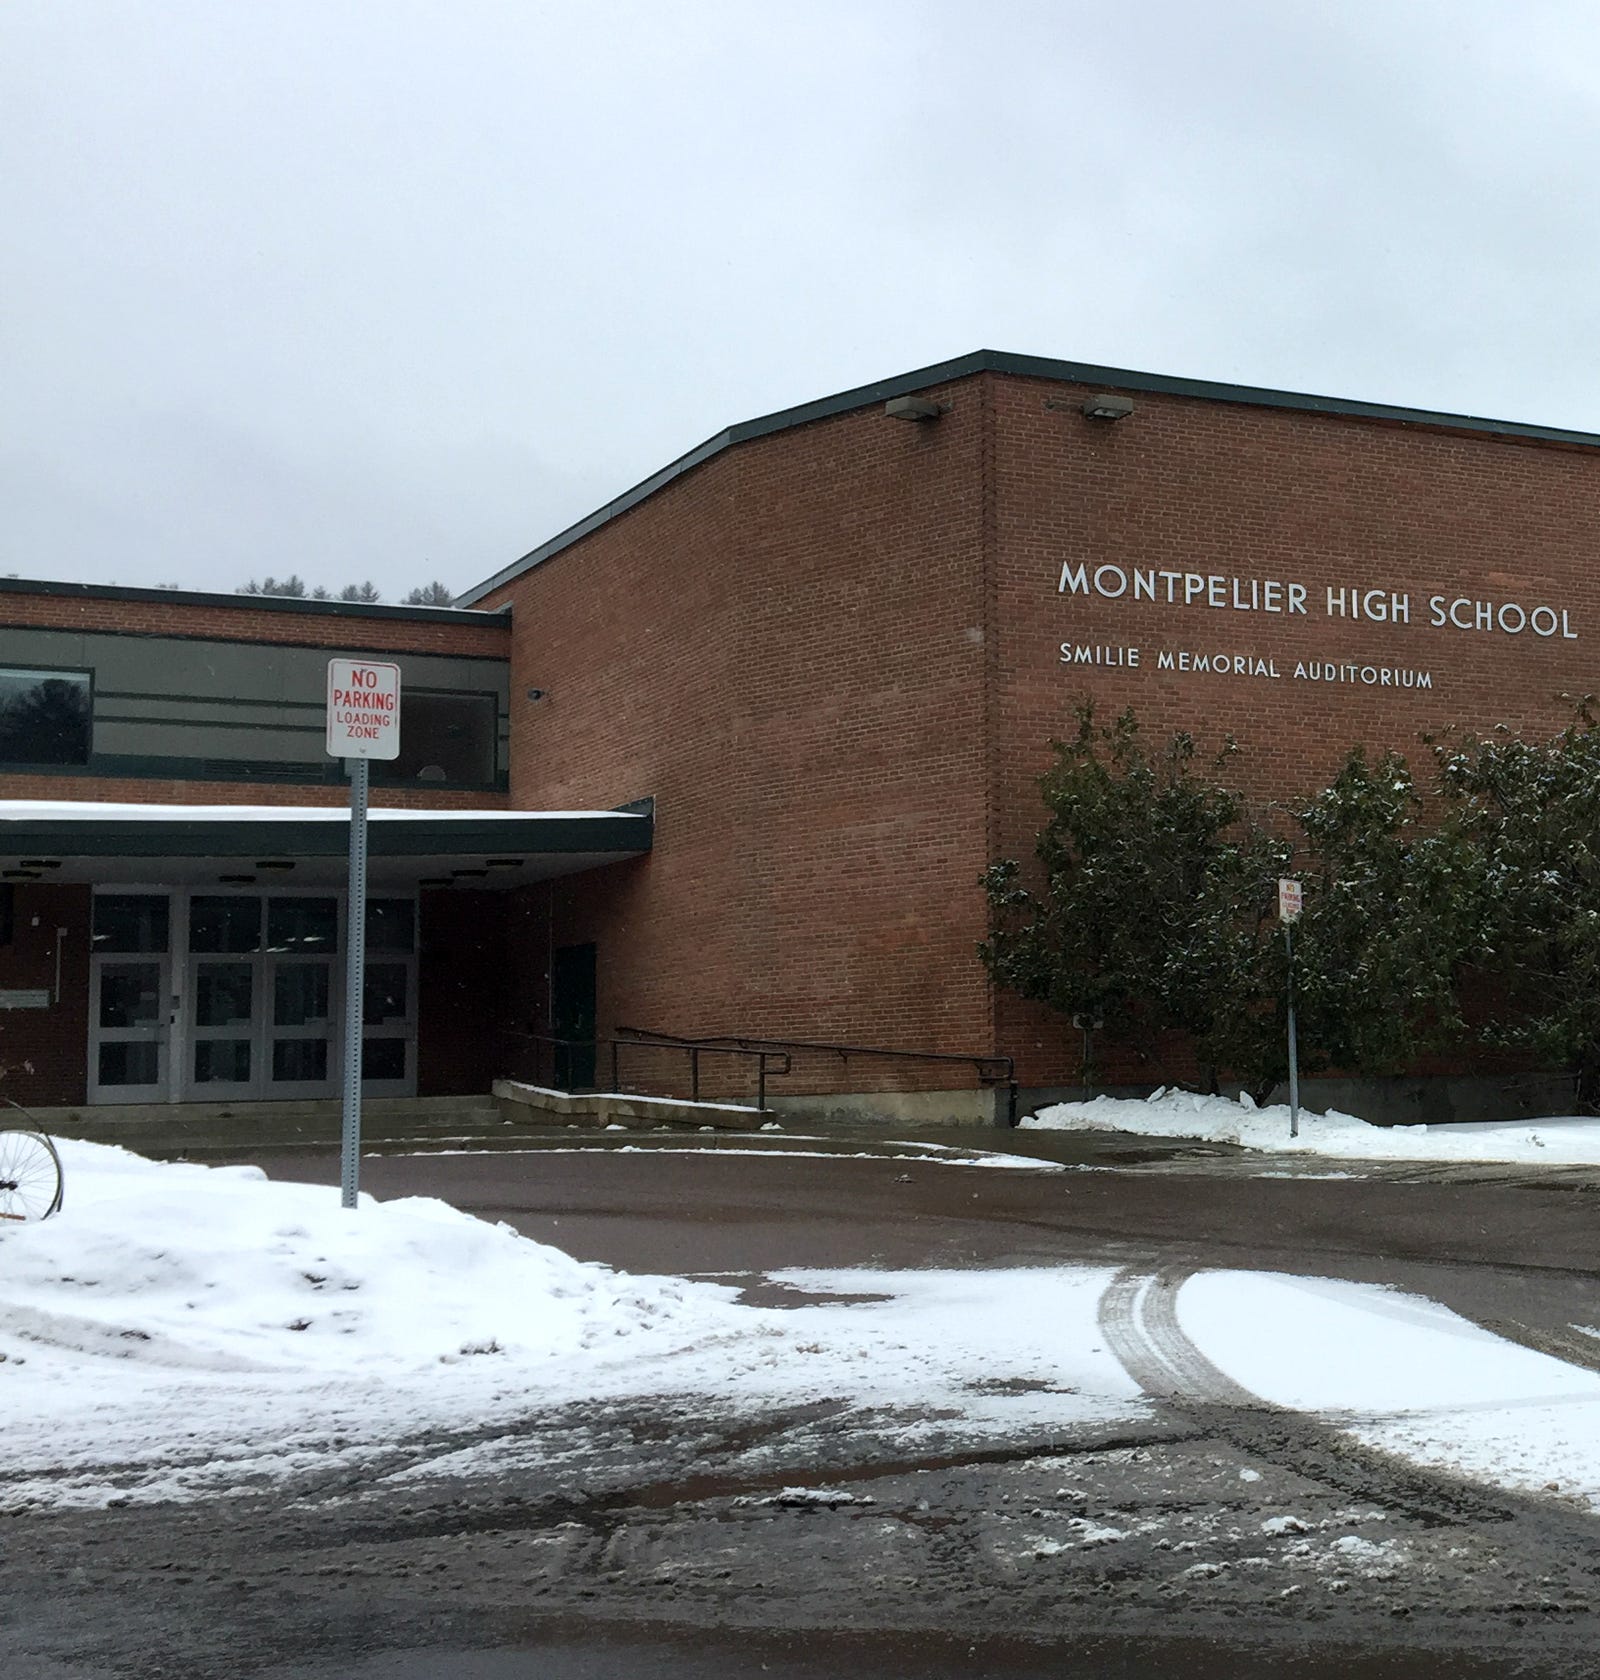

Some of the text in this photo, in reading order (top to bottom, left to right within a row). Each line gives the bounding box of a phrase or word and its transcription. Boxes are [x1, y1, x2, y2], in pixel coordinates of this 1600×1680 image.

[1058, 560, 1578, 639] MONTPELIER HIGH SCHOOL
[1059, 642, 1432, 689] SMILIE MEMORIAL AUDITORIUM
[352, 670, 377, 688] NO
[334, 689, 394, 711] PARKING
[337, 711, 390, 727] LOADING
[347, 726, 379, 739] ZONE
